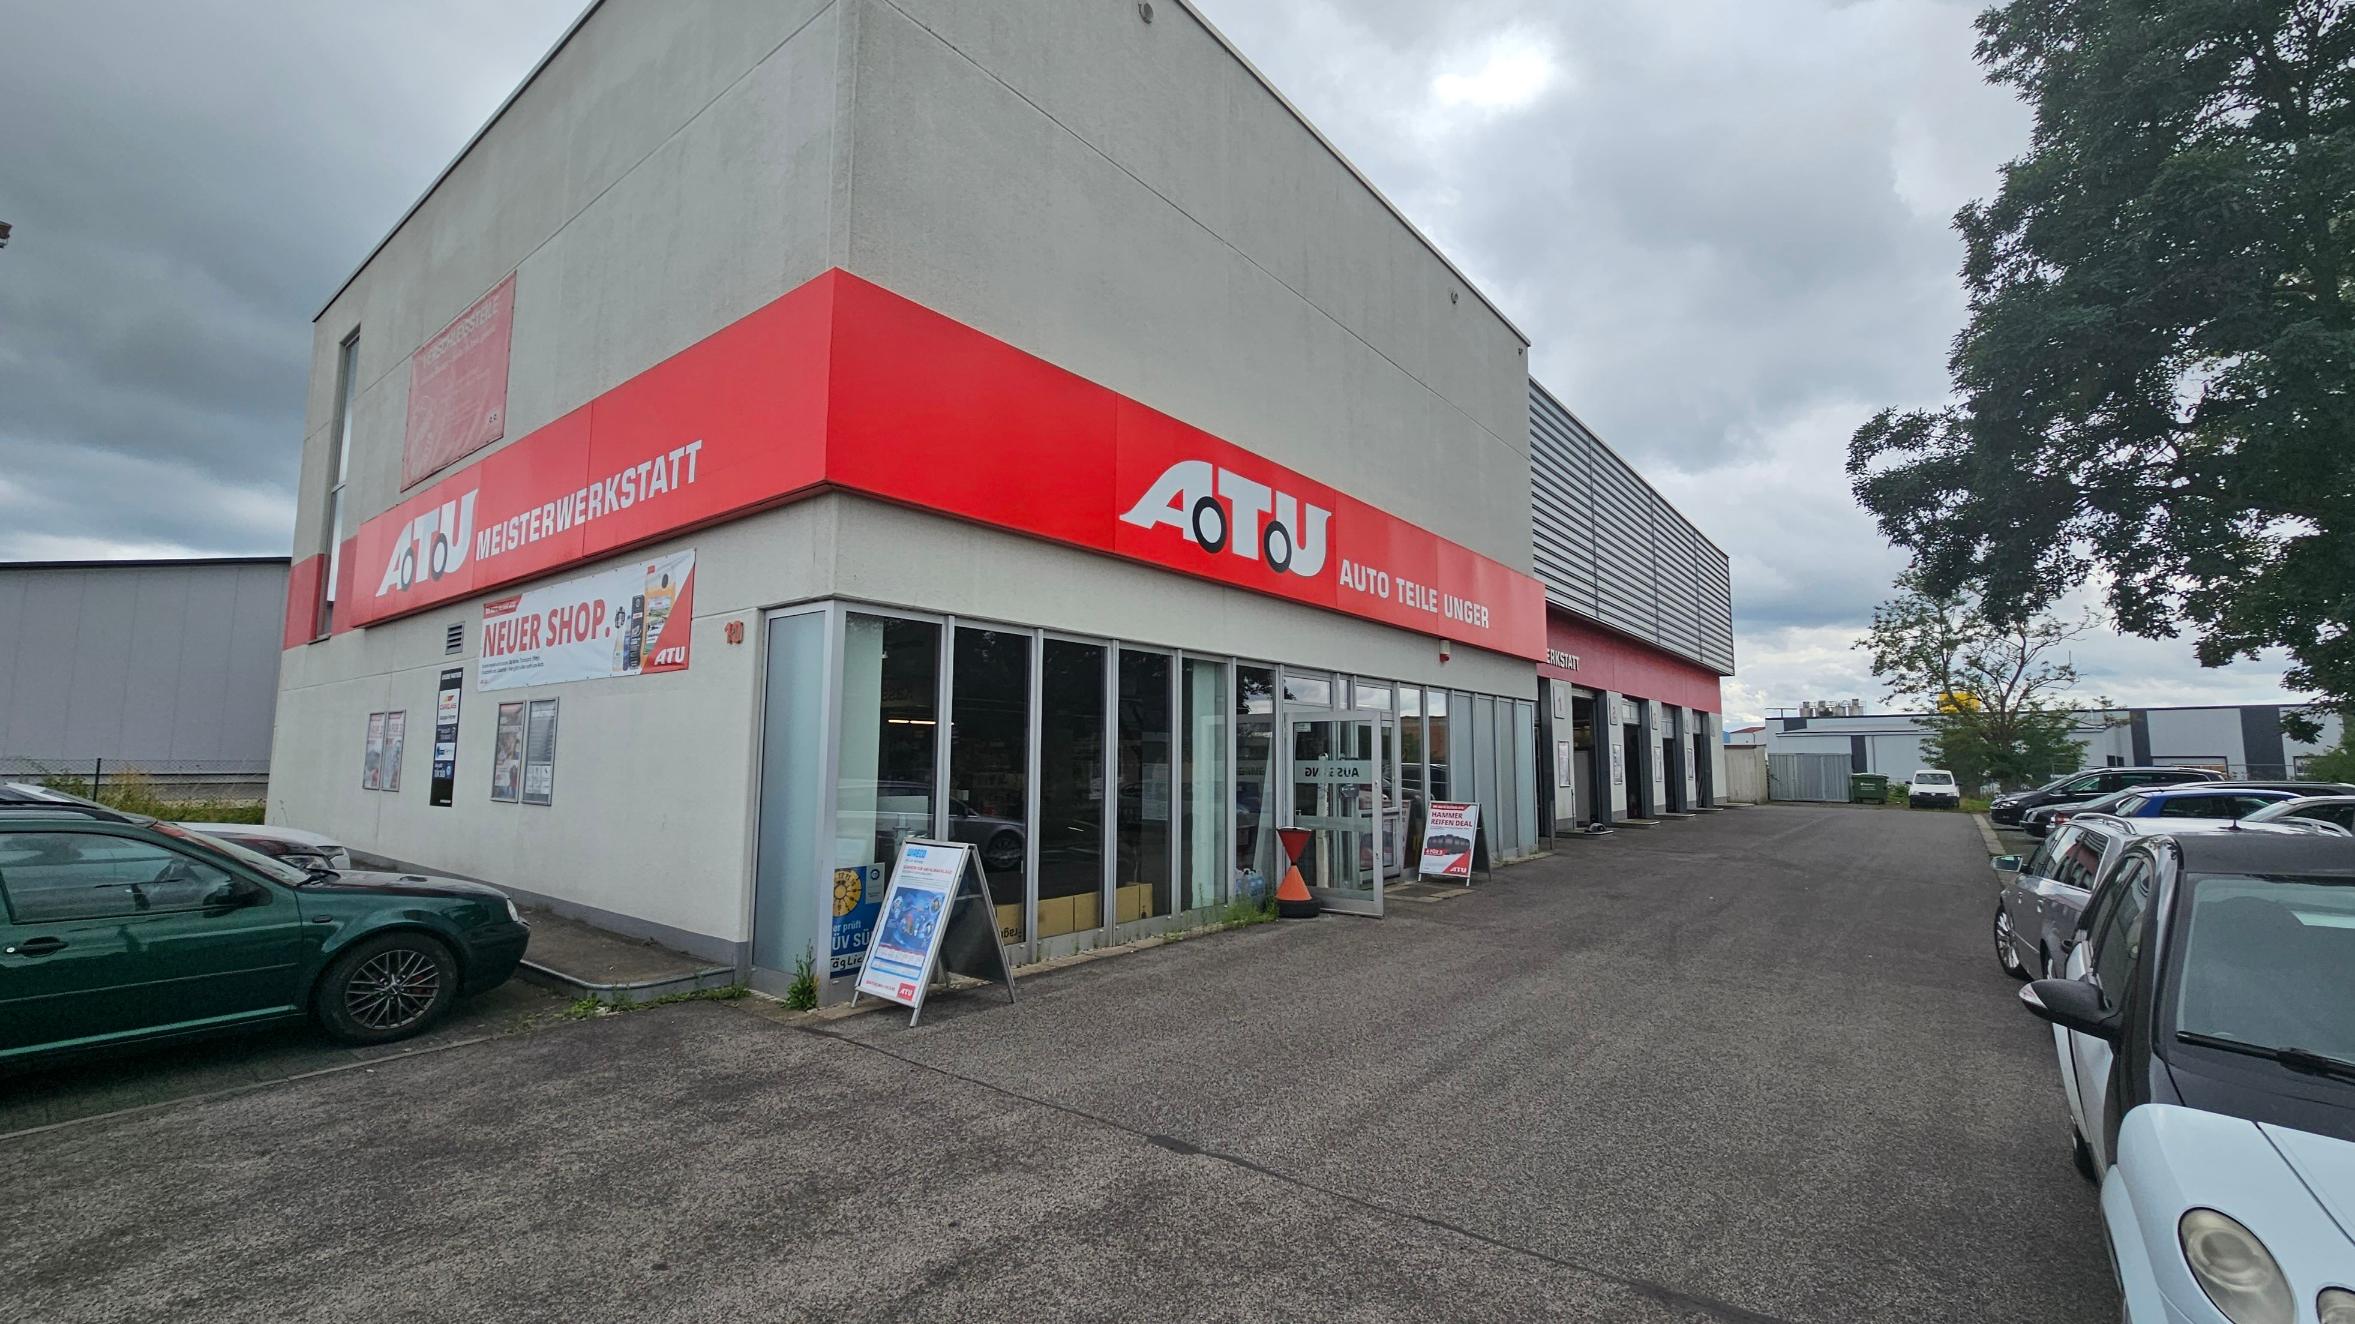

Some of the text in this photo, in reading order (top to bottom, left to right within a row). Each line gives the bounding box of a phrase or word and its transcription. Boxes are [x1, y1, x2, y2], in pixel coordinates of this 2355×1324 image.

[475, 440, 702, 561] MEISTERWERKSTATT
[1119, 460, 1332, 577] ATU
[376, 488, 479, 597] ATU
[1339, 558, 1489, 630] AUTO TEILE UNGER
[482, 598, 612, 659] NEUER SHOP.
[654, 646, 686, 666] ATU
[1546, 648, 1580, 671] ERKSTATT
[1430, 818, 1454, 826] REIFEN
[1431, 811, 1463, 819] HAMMER
[842, 920, 861, 933] prüft
[832, 928, 870, 951] ÜV SÜ
[831, 955, 863, 970] äglic
